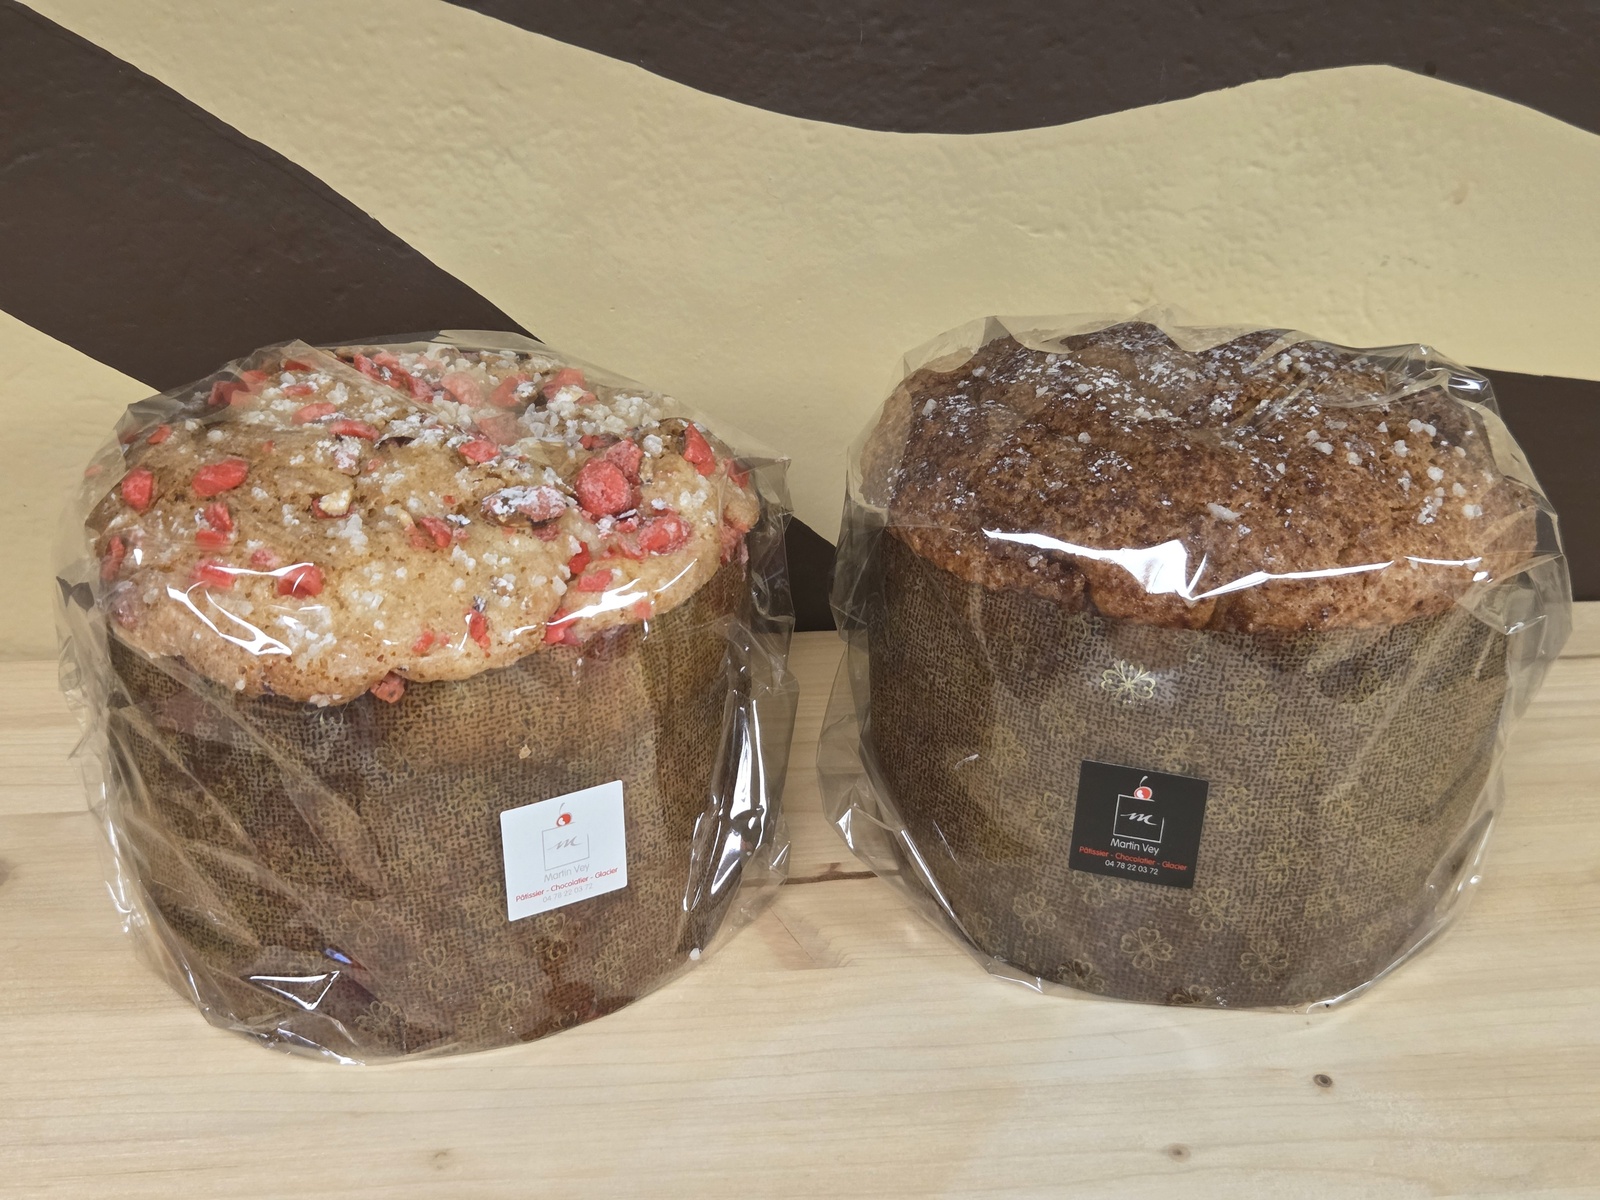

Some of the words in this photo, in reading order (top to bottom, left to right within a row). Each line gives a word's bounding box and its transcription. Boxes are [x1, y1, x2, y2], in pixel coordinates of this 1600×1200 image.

[1110, 838, 1140, 851] Martin
[1142, 843, 1160, 856] Vey
[1079, 846, 1109, 858] Pâtissier
[1115, 852, 1156, 866] Chocolatier
[1161, 861, 1188, 871] Glacier
[544, 868, 572, 883] Martin
[574, 863, 590, 873] Vey
[1116, 862, 1126, 870] 78
[1127, 864, 1137, 872] 22
[1138, 865, 1148, 873] 03
[1149, 868, 1159, 876] 72
[515, 888, 545, 902] Pâtissier
[550, 876, 589, 892] Chocolatier
[594, 867, 618, 879] Glacier
[542, 895, 552, 903] 04
[553, 892, 562, 900] 78
[564, 889, 573, 897] 22
[574, 886, 583, 894] 03
[584, 883, 593, 891] 72
